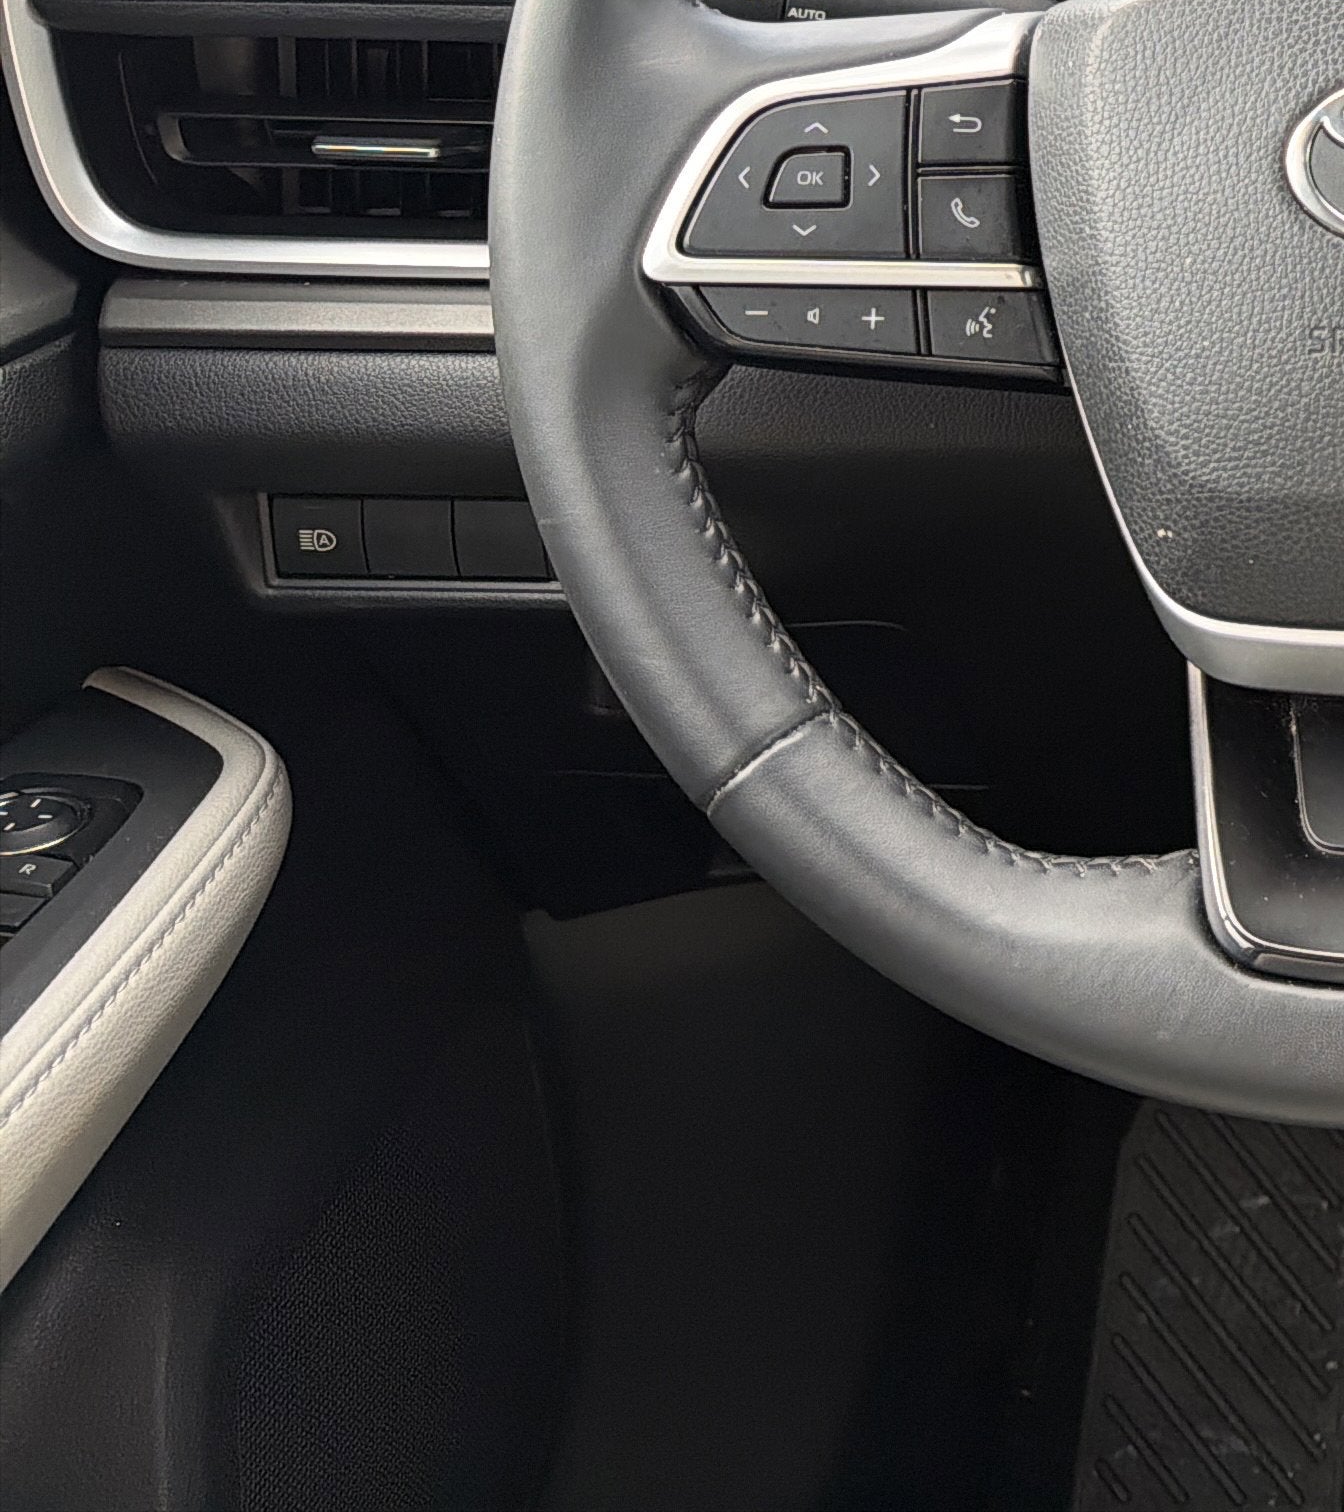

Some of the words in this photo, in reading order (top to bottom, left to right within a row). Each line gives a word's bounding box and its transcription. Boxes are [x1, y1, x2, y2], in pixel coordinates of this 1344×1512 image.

[786, 6, 826, 21] AUTO
[796, 171, 824, 186] OK
[18, 864, 37, 876] R
